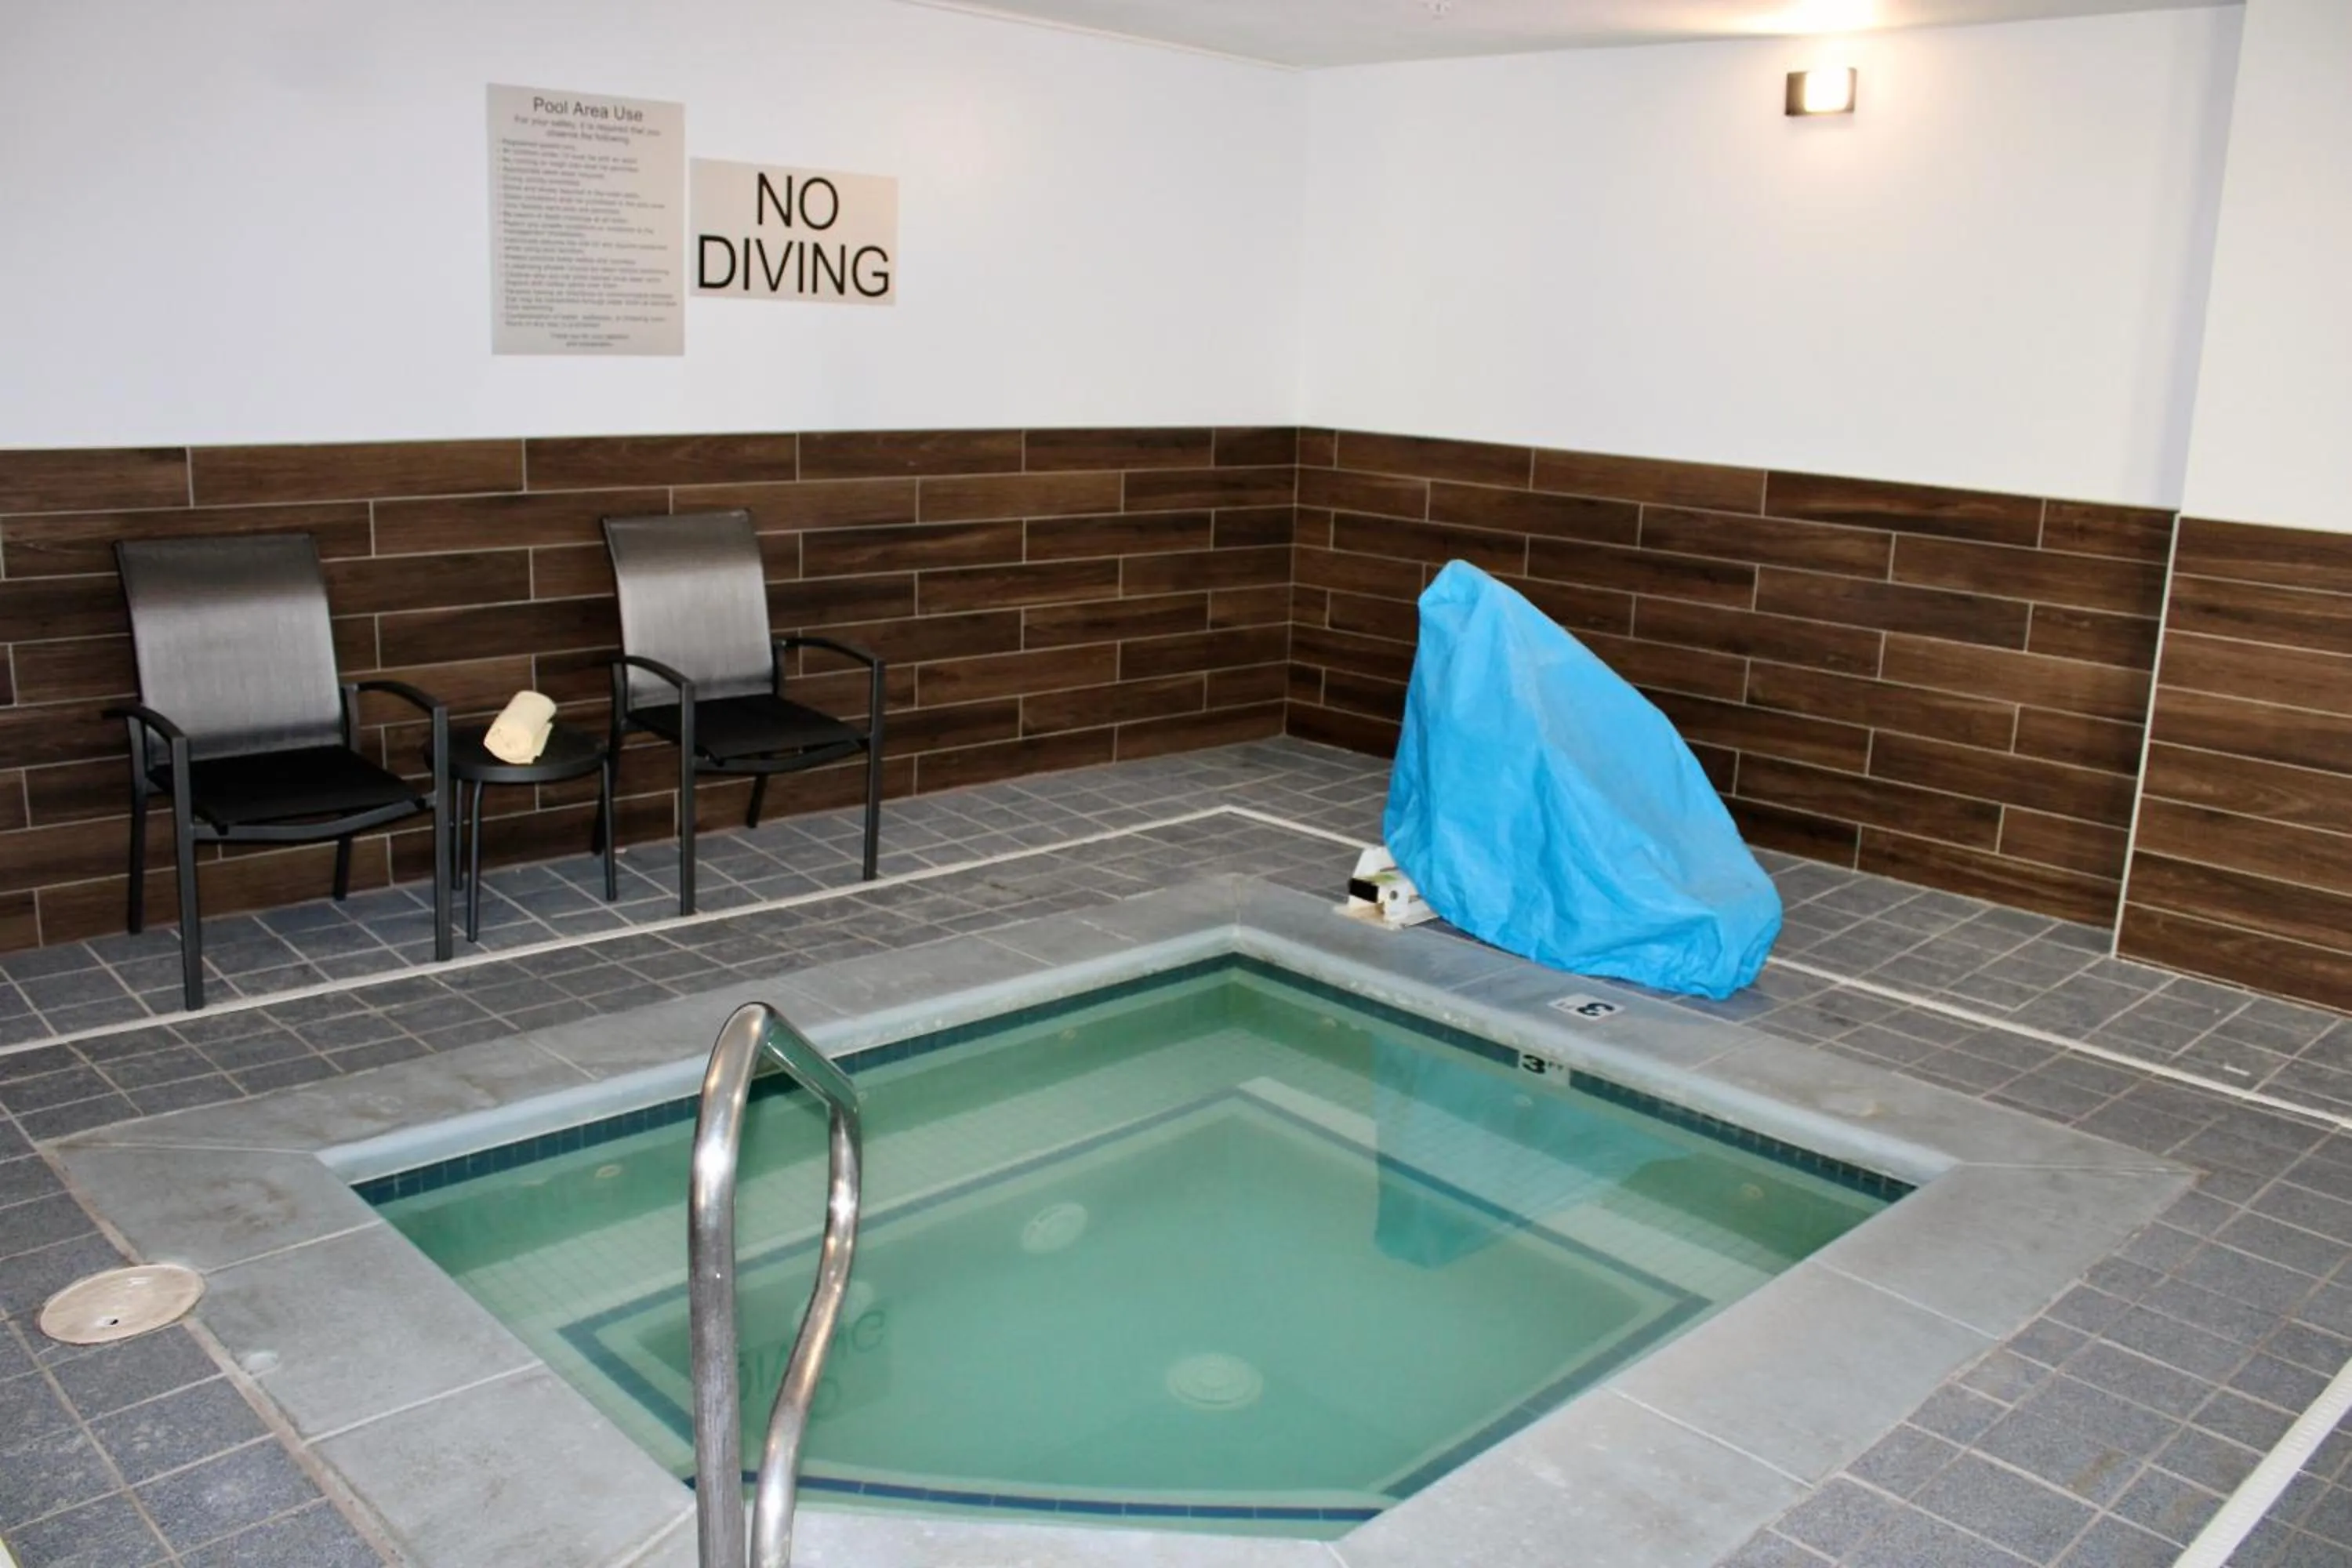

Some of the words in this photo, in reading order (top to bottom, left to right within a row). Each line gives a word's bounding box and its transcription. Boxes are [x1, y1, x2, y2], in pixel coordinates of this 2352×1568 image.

[533, 96, 568, 114] Pool
[572, 101, 608, 119] Area
[614, 105, 644, 122] Use
[757, 172, 839, 230] NO
[699, 234, 889, 297] DIVING
[1577, 1003, 1615, 1017] 3
[1522, 1054, 1546, 1074] 3
